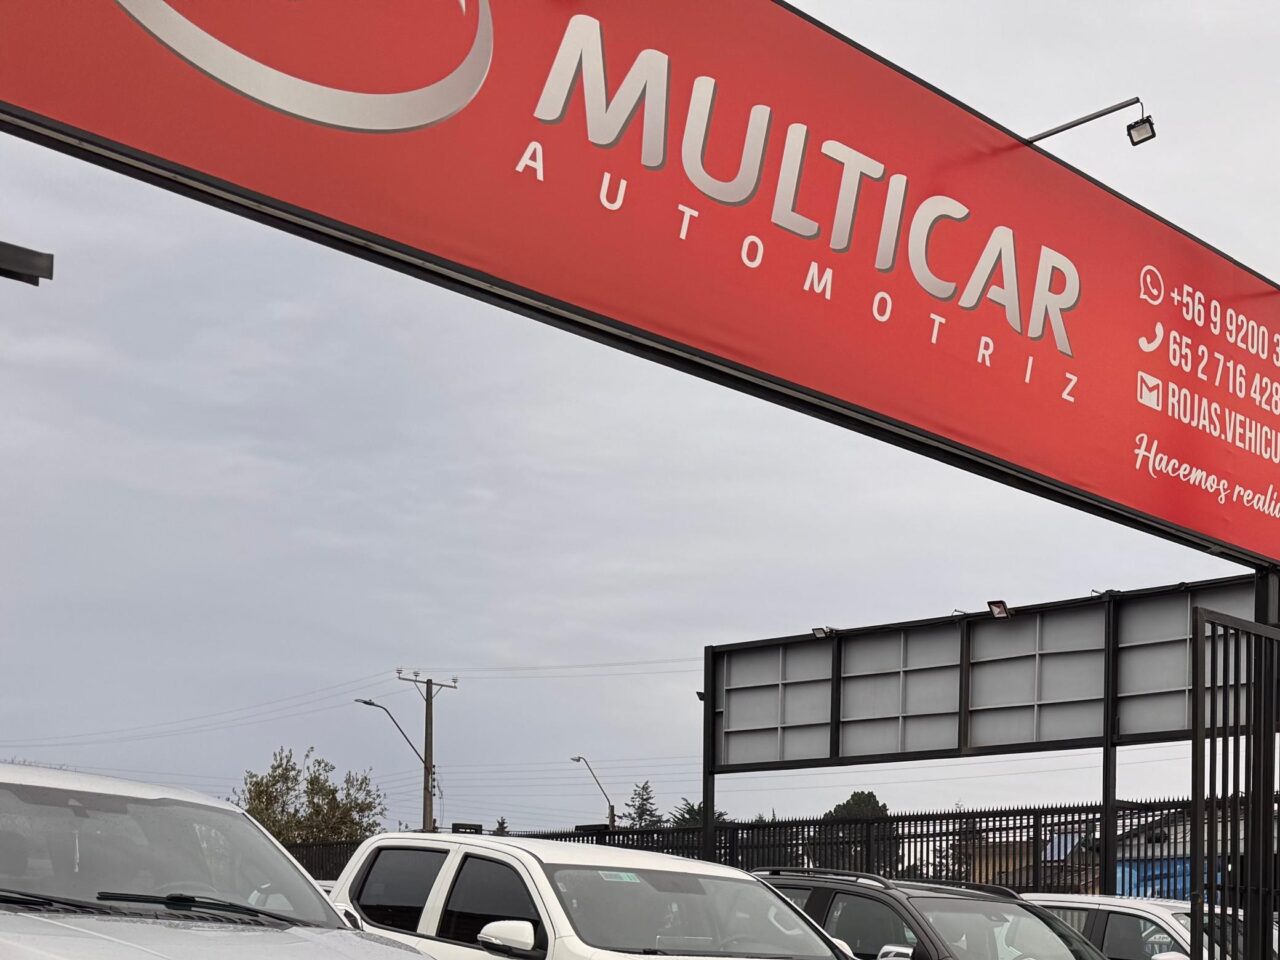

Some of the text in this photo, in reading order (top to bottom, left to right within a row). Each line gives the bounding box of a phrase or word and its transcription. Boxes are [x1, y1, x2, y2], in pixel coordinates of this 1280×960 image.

[533, 14, 1081, 357] MULTICAR
[515, 141, 1078, 404] AUTOMOTRIZ
[1170, 284, 1205, 327] +56
[1210, 300, 1221, 336] 9
[1226, 308, 1269, 360] 9200
[1169, 330, 1192, 372] 65
[1197, 344, 1209, 382] 2
[1214, 352, 1246, 399] 716
[1133, 433, 1230, 504] Hacemos
